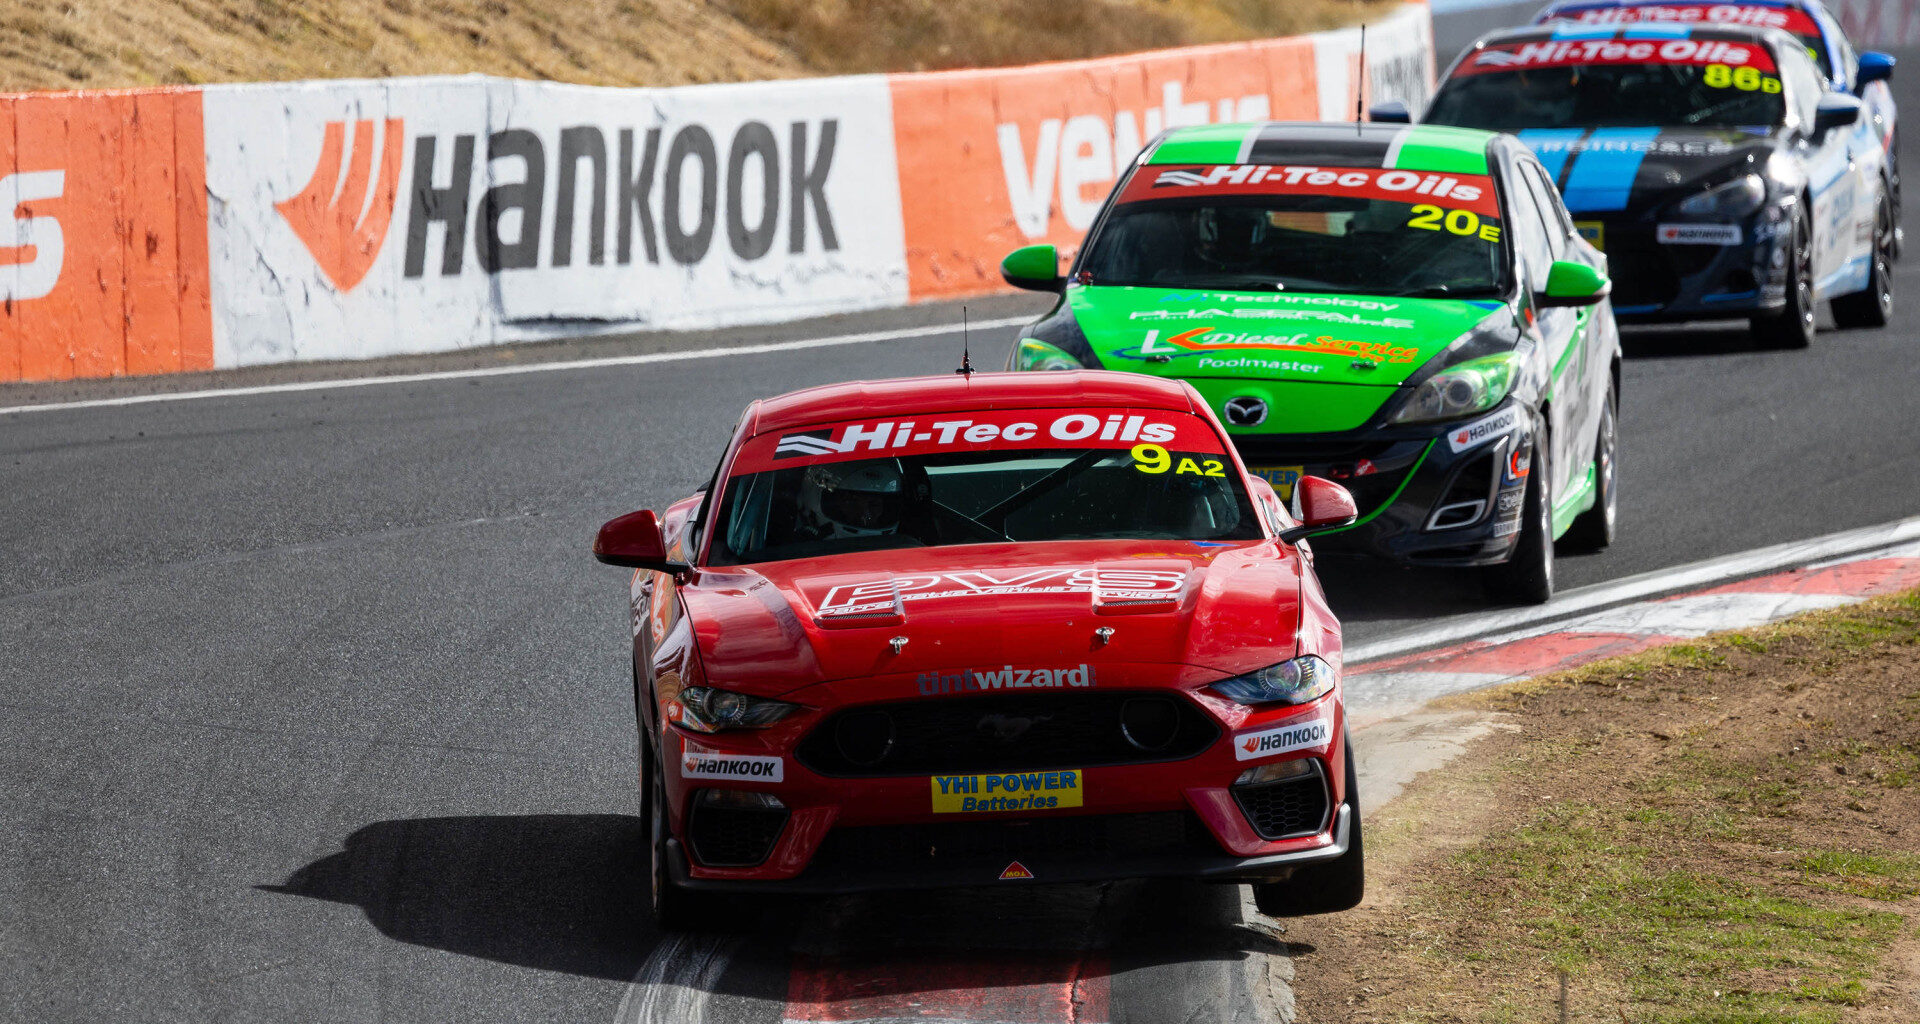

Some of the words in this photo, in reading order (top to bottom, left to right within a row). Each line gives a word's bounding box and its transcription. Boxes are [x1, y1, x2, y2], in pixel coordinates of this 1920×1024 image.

[1517, 41, 1655, 64] Hi-Tec
[1659, 40, 1751, 64] Oils
[1206, 166, 1369, 187] Hi-Tec
[1376, 169, 1483, 201] Oils
[1212, 294, 1399, 311] Technology
[1202, 333, 1308, 346] Diesel
[1305, 335, 1419, 357] Service
[1199, 357, 1323, 373] Poolmaster
[837, 419, 1038, 453] Hi-Tec
[1049, 414, 1179, 443] Oils
[819, 569, 1186, 609] PVS
[916, 664, 1089, 695] tintwizard
[936, 775, 978, 795] YHI
[987, 771, 1077, 793] POWER
[962, 795, 1058, 813] Batteries
